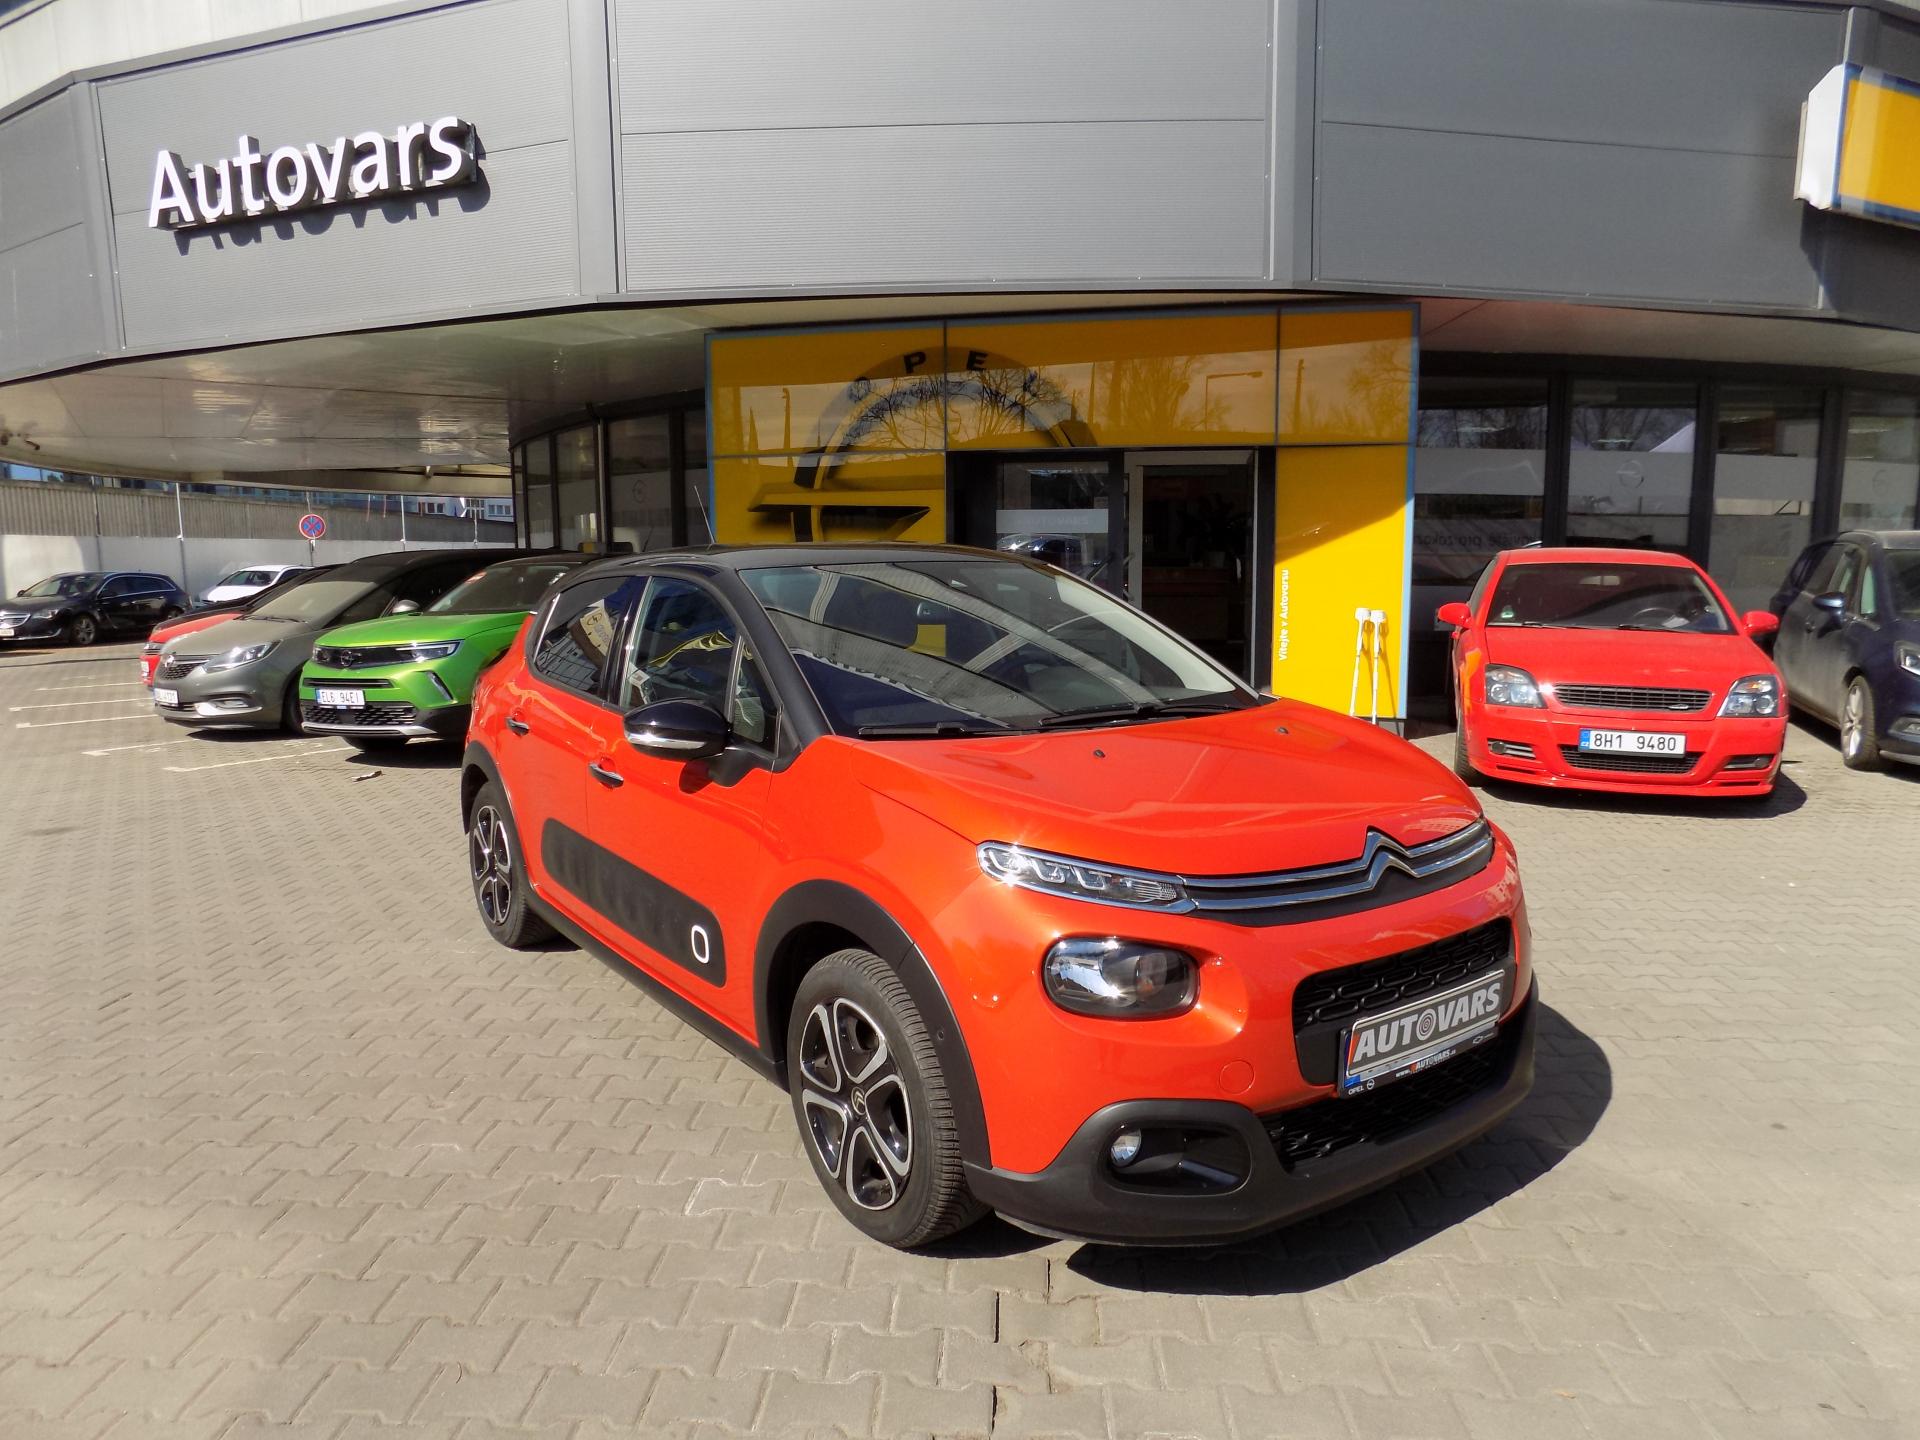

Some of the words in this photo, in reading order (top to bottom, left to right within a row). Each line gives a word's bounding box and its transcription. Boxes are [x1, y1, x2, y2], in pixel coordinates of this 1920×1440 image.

[148, 115, 464, 228] Autovars
[1279, 569, 1289, 619] Autovarsu
[1593, 733, 1624, 749] 8H1
[1636, 735, 1677, 751] 9480
[1353, 982, 1501, 1063] AUTOVARS
